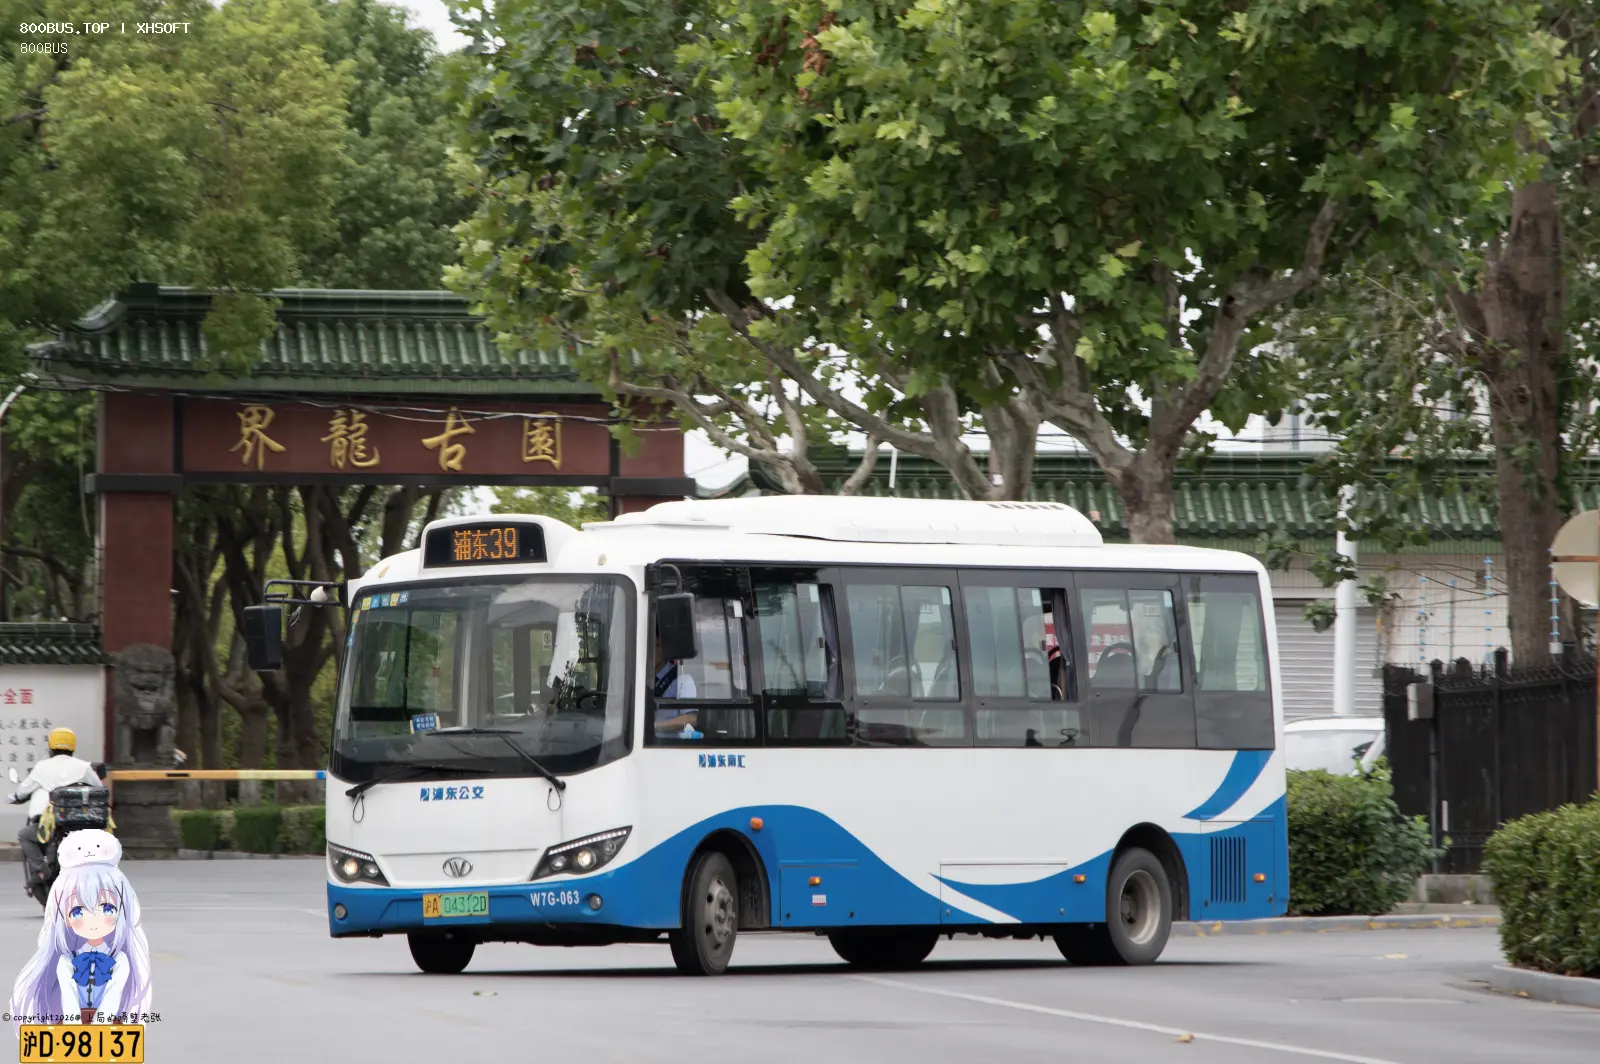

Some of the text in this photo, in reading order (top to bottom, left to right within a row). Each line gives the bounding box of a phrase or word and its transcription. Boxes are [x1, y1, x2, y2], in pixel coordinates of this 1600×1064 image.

[229, 403, 563, 471] 界龍古園
[453, 527, 517, 561] 浦东39
[707, 753, 746, 768] 浦东南汇
[432, 785, 484, 801] 浦东公交
[530, 890, 580, 907] W7G-063
